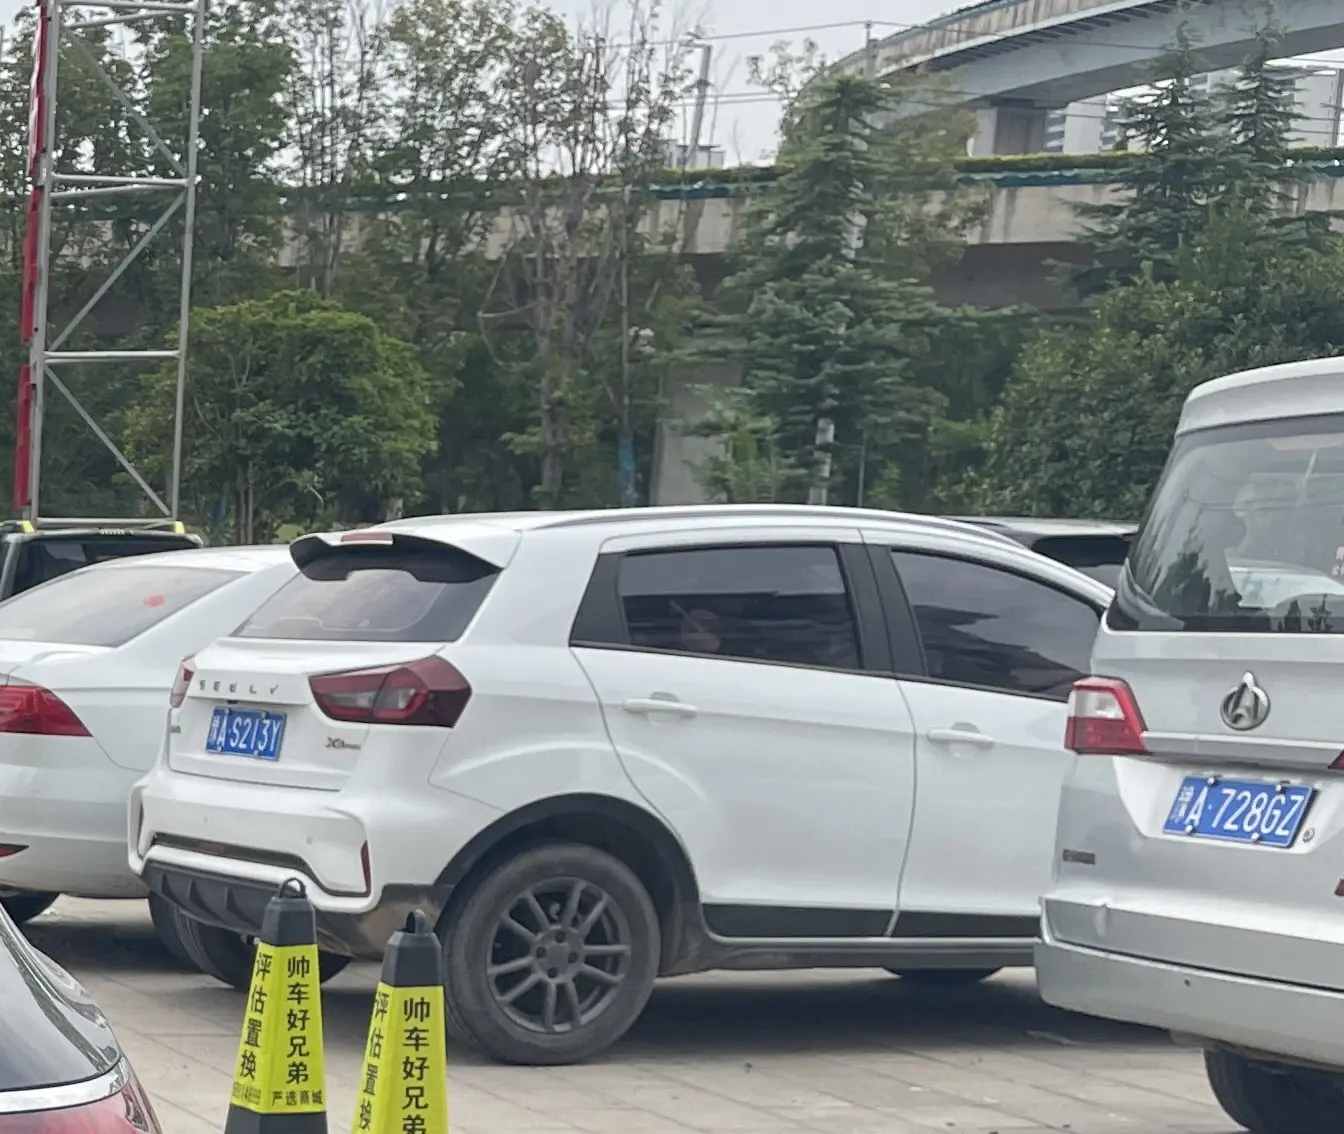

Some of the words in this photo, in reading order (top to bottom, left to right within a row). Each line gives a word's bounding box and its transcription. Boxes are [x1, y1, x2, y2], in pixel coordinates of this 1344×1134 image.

[239, 952, 273, 1080] 评估置换
[286, 956, 311, 1084] 帅车好兄弟
[359, 991, 390, 1132] 评估置换
